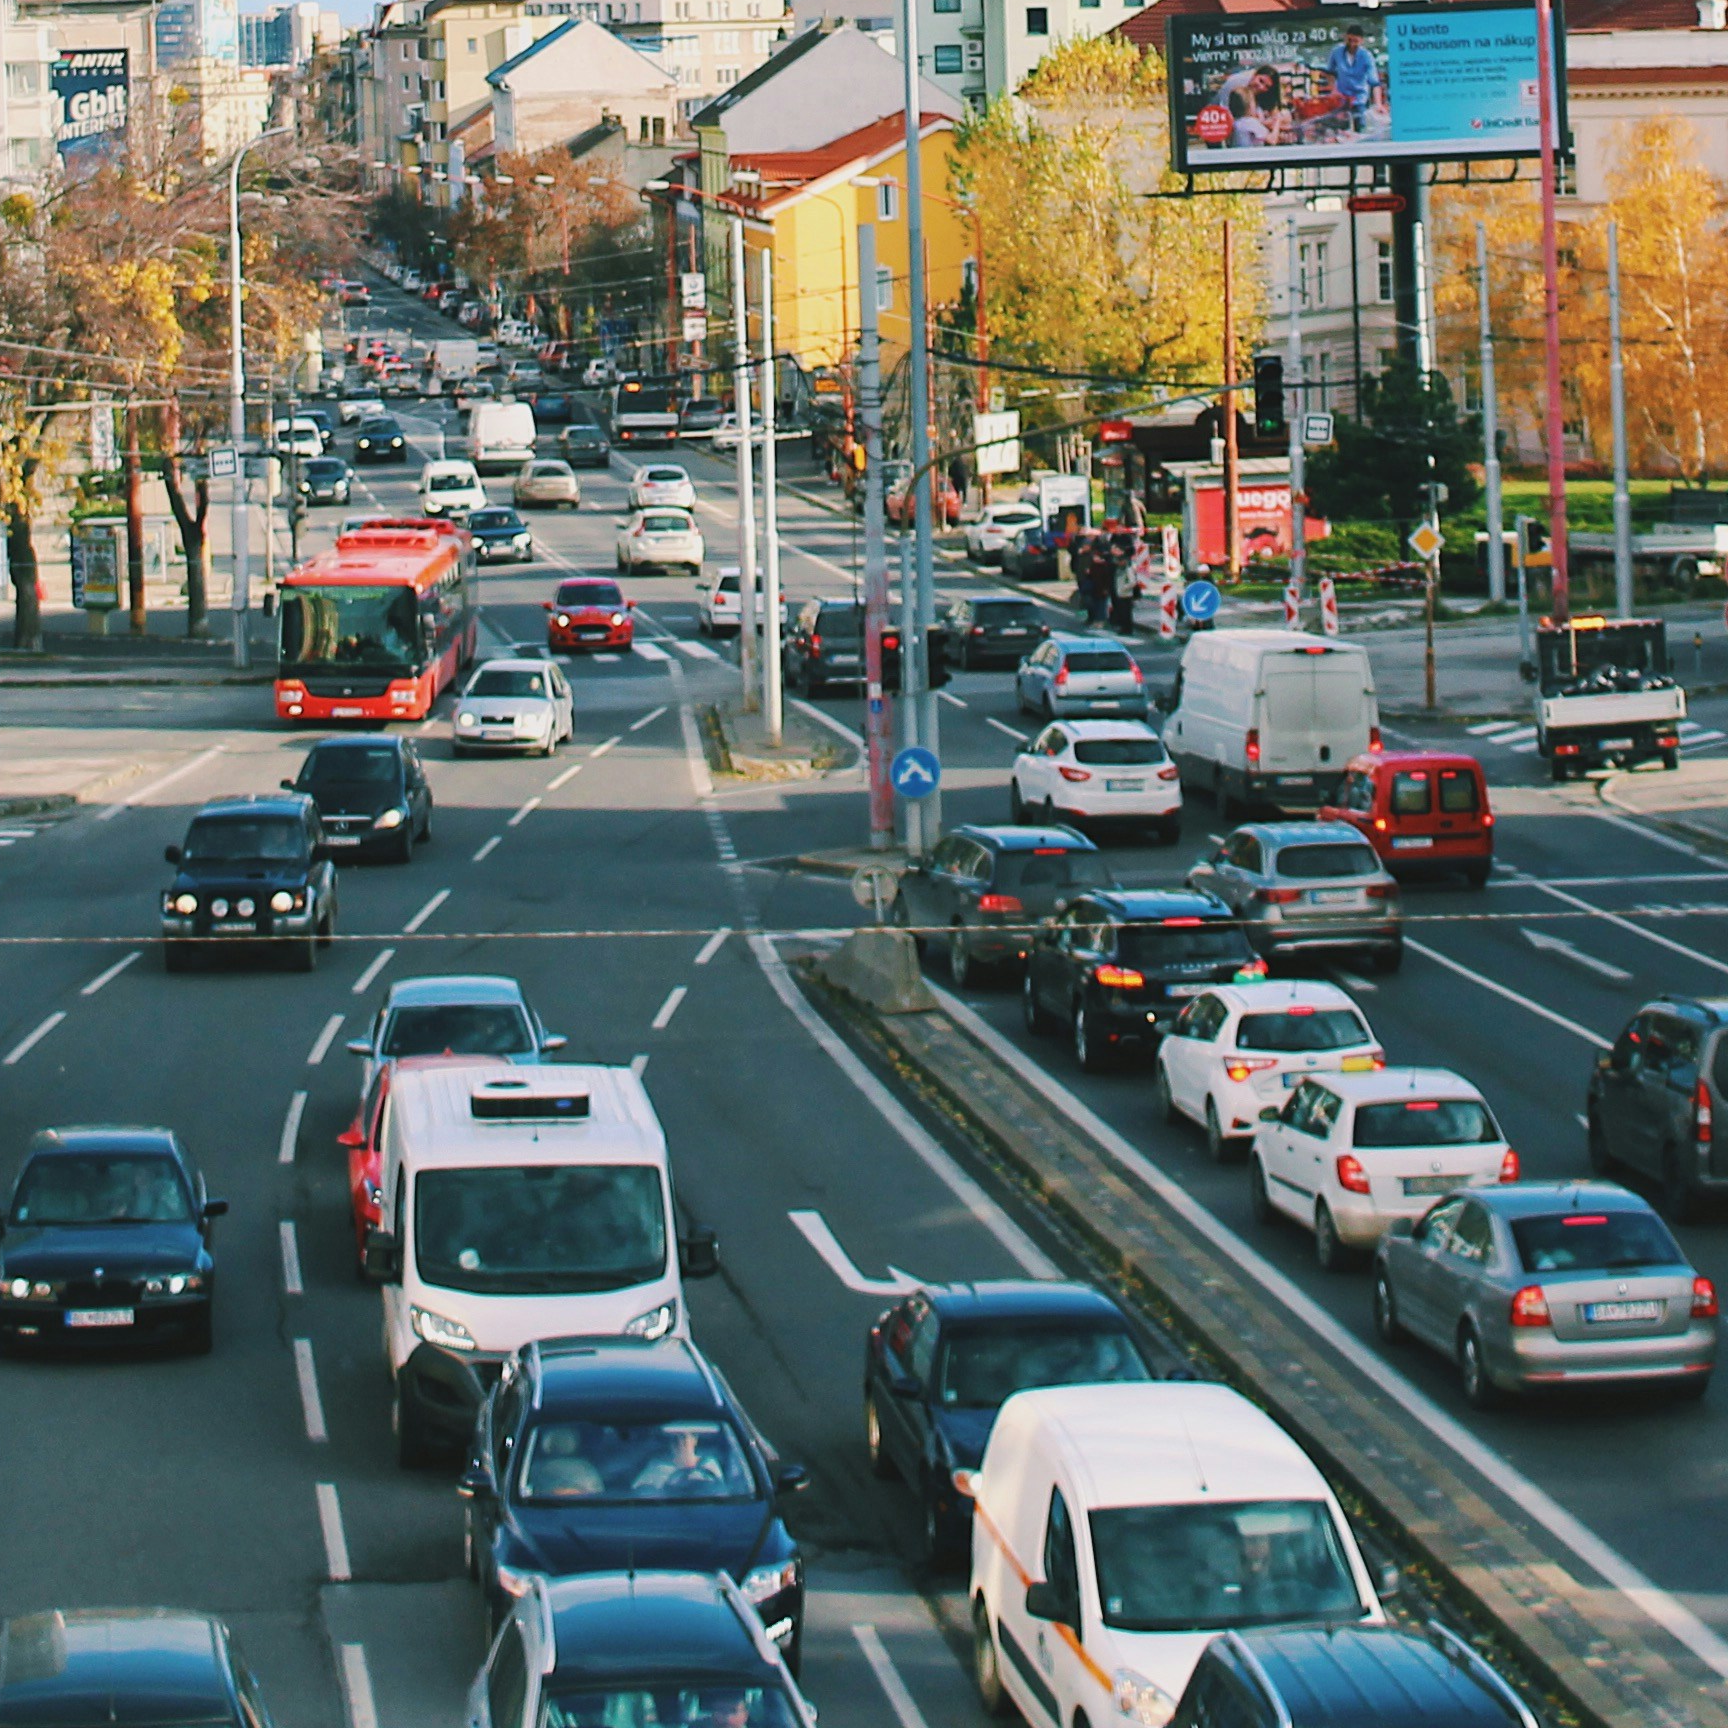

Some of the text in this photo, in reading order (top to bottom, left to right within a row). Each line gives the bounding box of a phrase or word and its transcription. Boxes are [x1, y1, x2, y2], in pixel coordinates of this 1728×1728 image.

[1191, 32, 1212, 48] My
[1214, 32, 1224, 46] si
[1228, 32, 1248, 46] ten
[1292, 31, 1306, 43] za
[1309, 28, 1327, 42] 40
[1397, 24, 1449, 36] U konto
[1409, 37, 1471, 51] bonusom
[1475, 37, 1490, 47] na
[1495, 33, 1536, 48] nákup
[70, 52, 125, 69] ANTIK
[1192, 49, 1229, 63] vieme
[70, 84, 126, 121] Gbit
